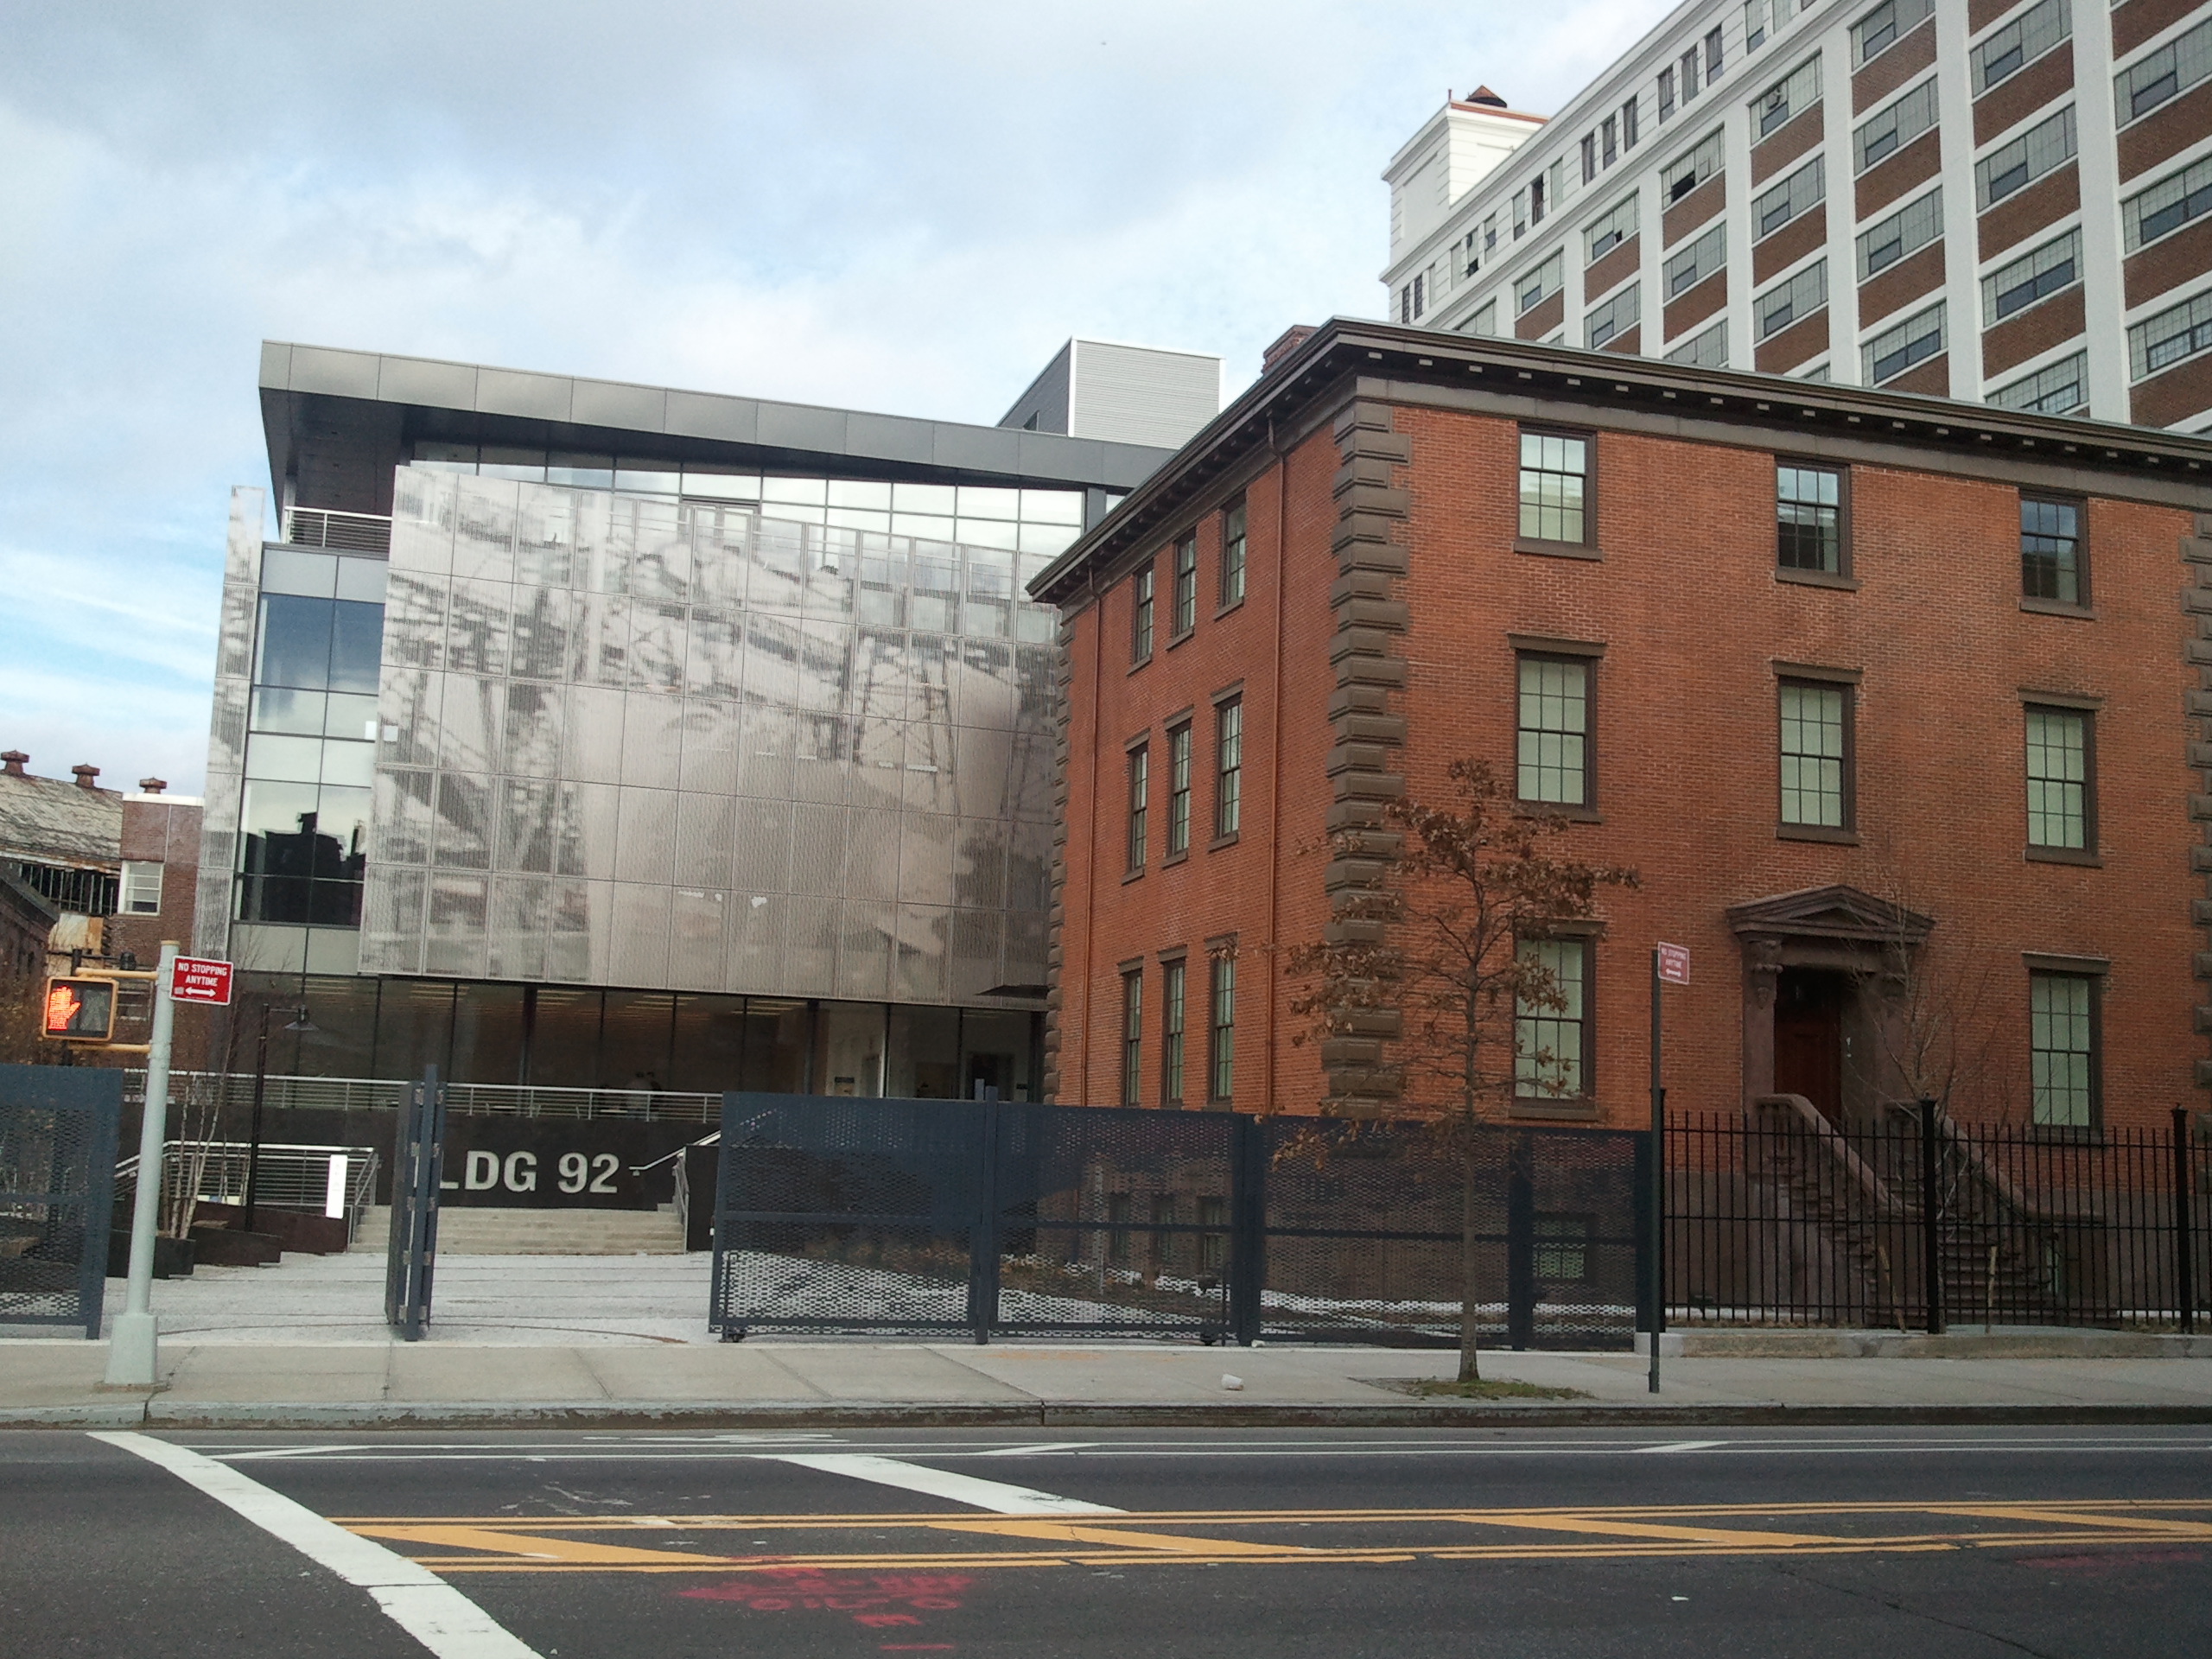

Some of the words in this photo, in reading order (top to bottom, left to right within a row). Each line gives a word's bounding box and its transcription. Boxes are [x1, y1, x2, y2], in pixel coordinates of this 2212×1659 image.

[177, 962, 189, 972] NO
[191, 963, 228, 976] STOPPING
[185, 975, 219, 987] ANYTIME
[439, 1150, 537, 1192] LDG
[557, 1152, 620, 1194] 92
